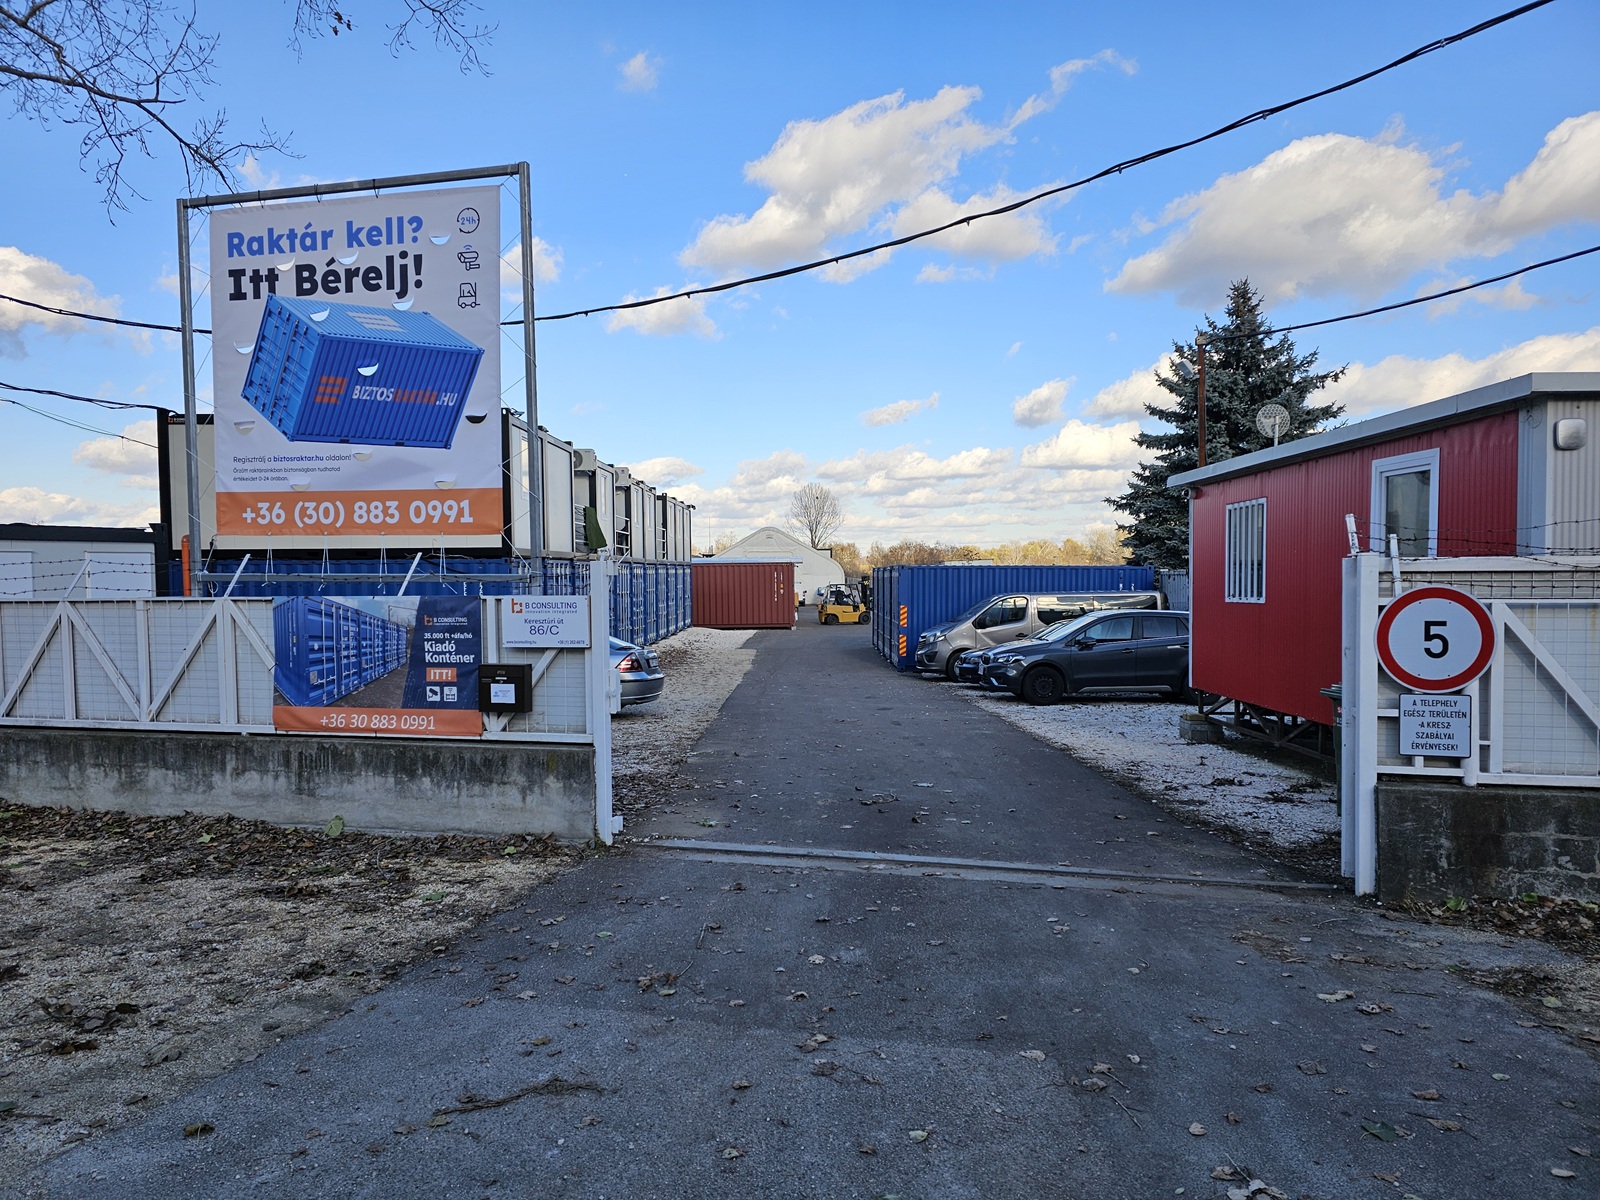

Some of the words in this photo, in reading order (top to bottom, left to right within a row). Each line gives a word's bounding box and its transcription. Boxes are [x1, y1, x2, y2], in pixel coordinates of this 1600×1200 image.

[460, 216, 477, 225] 24h
[227, 221, 334, 258] Raktár
[346, 215, 423, 248] kell?
[228, 267, 279, 301] Itt
[295, 250, 423, 300] Bérelj!
[233, 456, 266, 464] Regisztrálj
[273, 454, 324, 463] biztosraktar.hu
[325, 453, 352, 461] oldalon!
[284, 465, 317, 473] biztonságban
[242, 501, 285, 524] +36
[294, 501, 345, 528] (30)
[353, 501, 400, 523] 883
[409, 500, 473, 523] 0991
[531, 602, 578, 610] CONSULTING
[529, 625, 559, 636] 86/C
[1424, 620, 1449, 659] 5
[424, 640, 456, 652] Kiadó
[425, 652, 475, 663] Konténer
[430, 669, 452, 680] ITT!
[1412, 699, 1417, 707] A
[1420, 699, 1458, 708] TELEPHELY
[1403, 708, 1426, 718] EGÉSZ
[1428, 709, 1467, 719] TERÜLETÉN
[320, 713, 346, 728] +36
[349, 714, 368, 728] 30
[370, 714, 397, 729] 883
[401, 715, 436, 730] 0991
[1415, 730, 1455, 740] SZABÁLYAI
[1411, 740, 1458, 752] ÉRVÉNYESEK!
